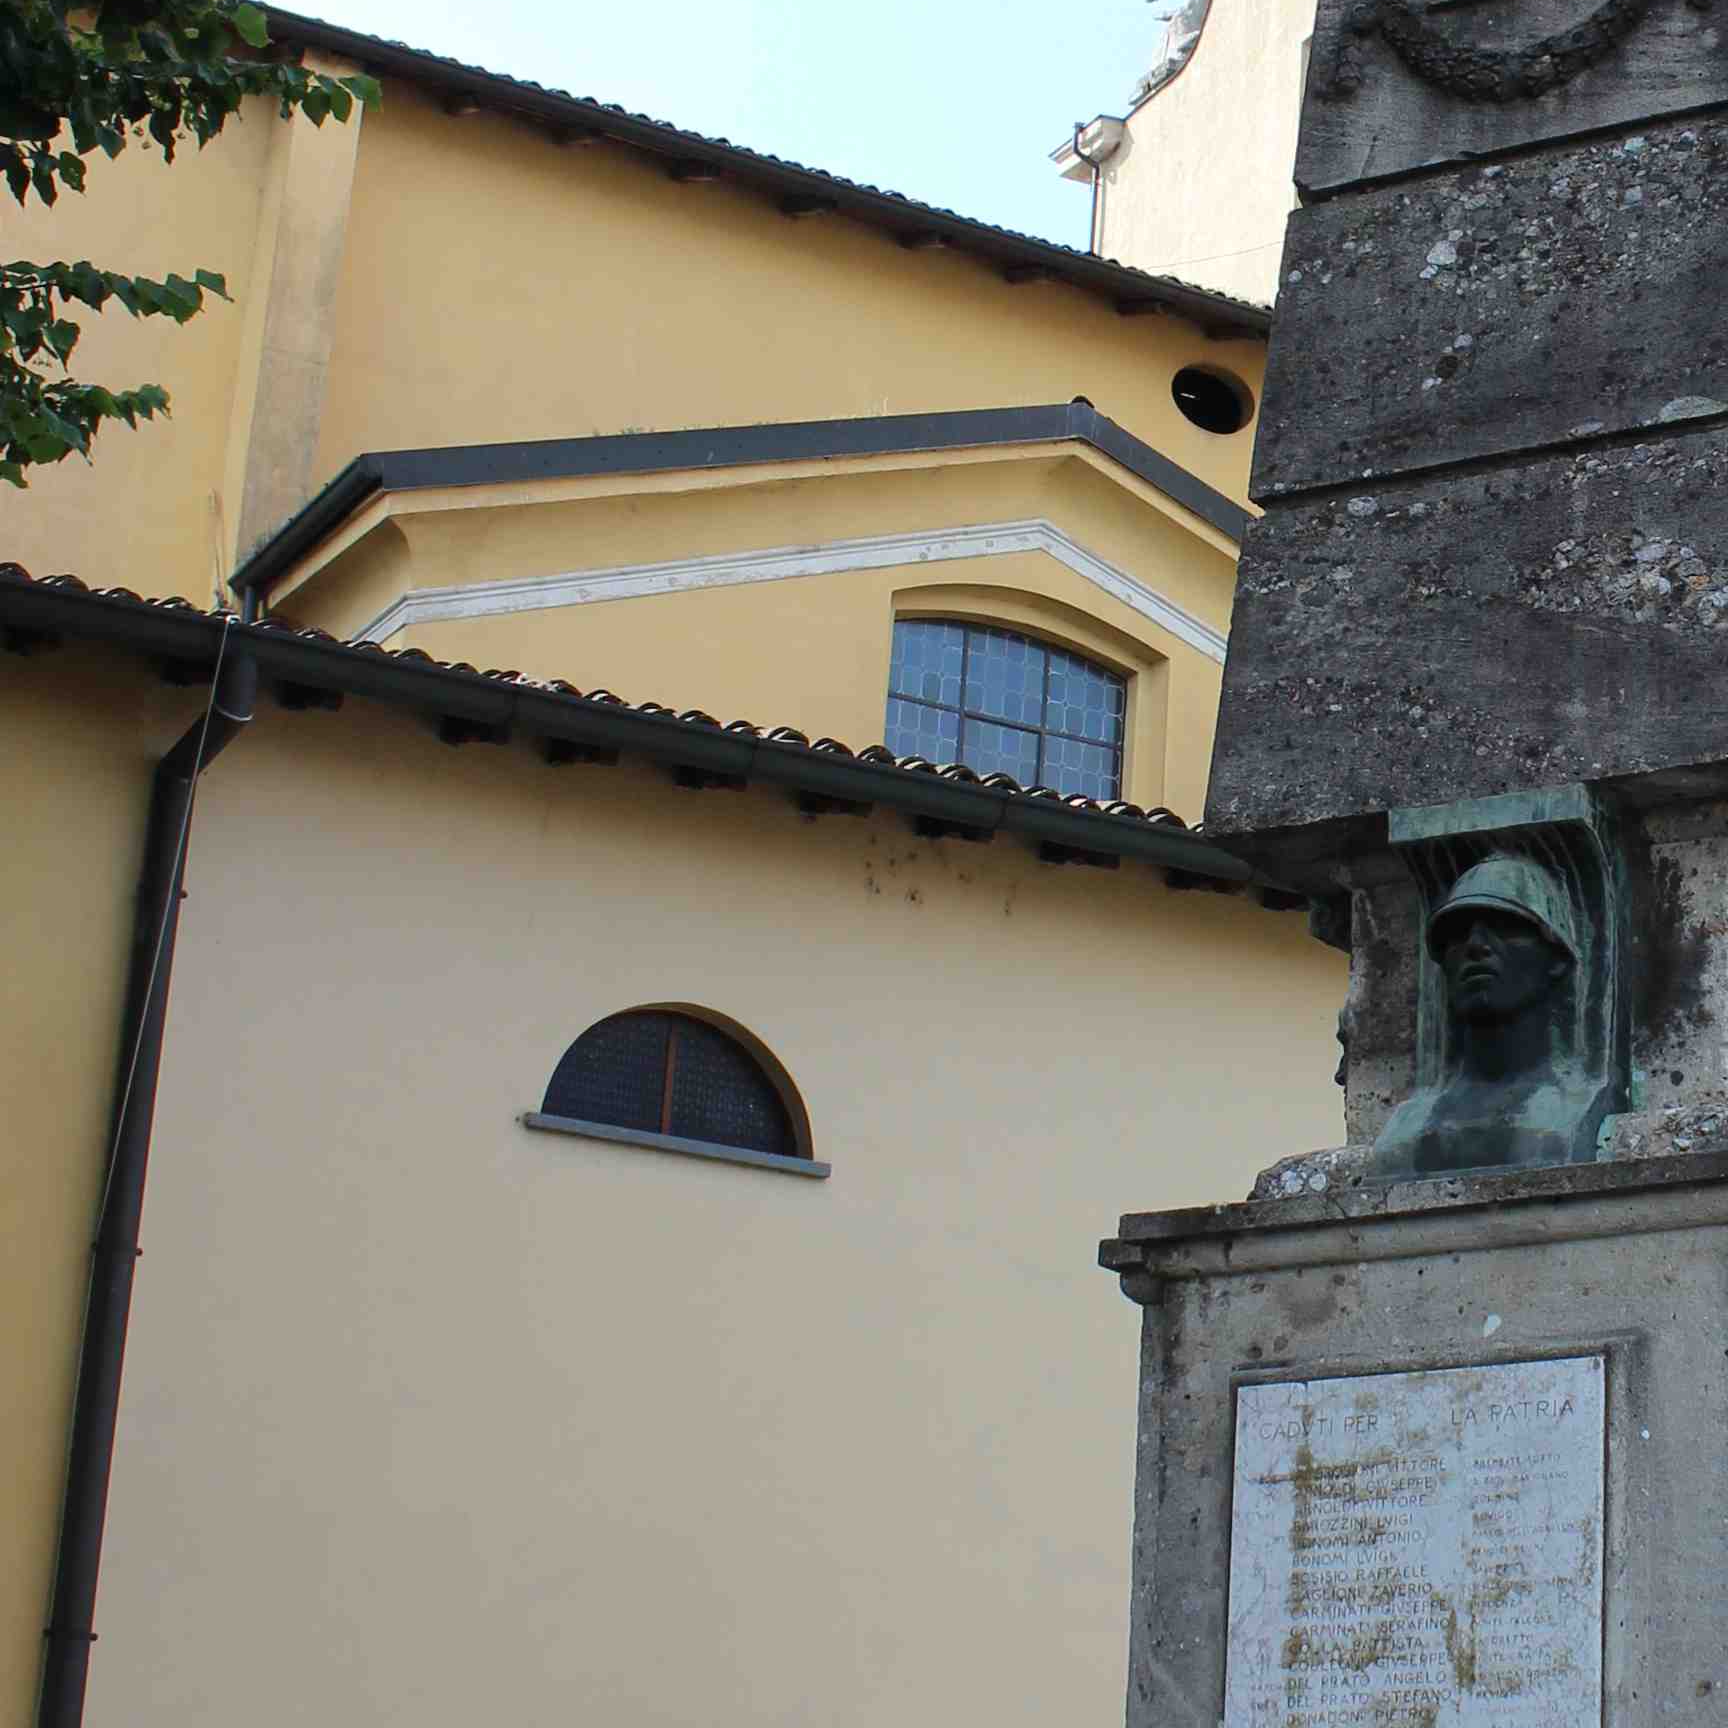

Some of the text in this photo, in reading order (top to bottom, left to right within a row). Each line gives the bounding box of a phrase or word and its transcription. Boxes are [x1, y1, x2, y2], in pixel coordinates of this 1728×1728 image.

[1344, 1415, 1379, 1434] PER
[1451, 1408, 1478, 1425] LA
[1488, 1399, 1576, 1424] PATRIA
[1358, 1531, 1422, 1546] ANTONIO
[1356, 1565, 1430, 1581] RAFFAELE
[1371, 1582, 1433, 1601] ZAVERIO
[1287, 1670, 1447, 1691] DEL PRATO ANGELO
[1287, 1695, 1312, 1710] DEL
[1320, 1692, 1370, 1706] PRATO
[1381, 1687, 1453, 1705] STEFANO
